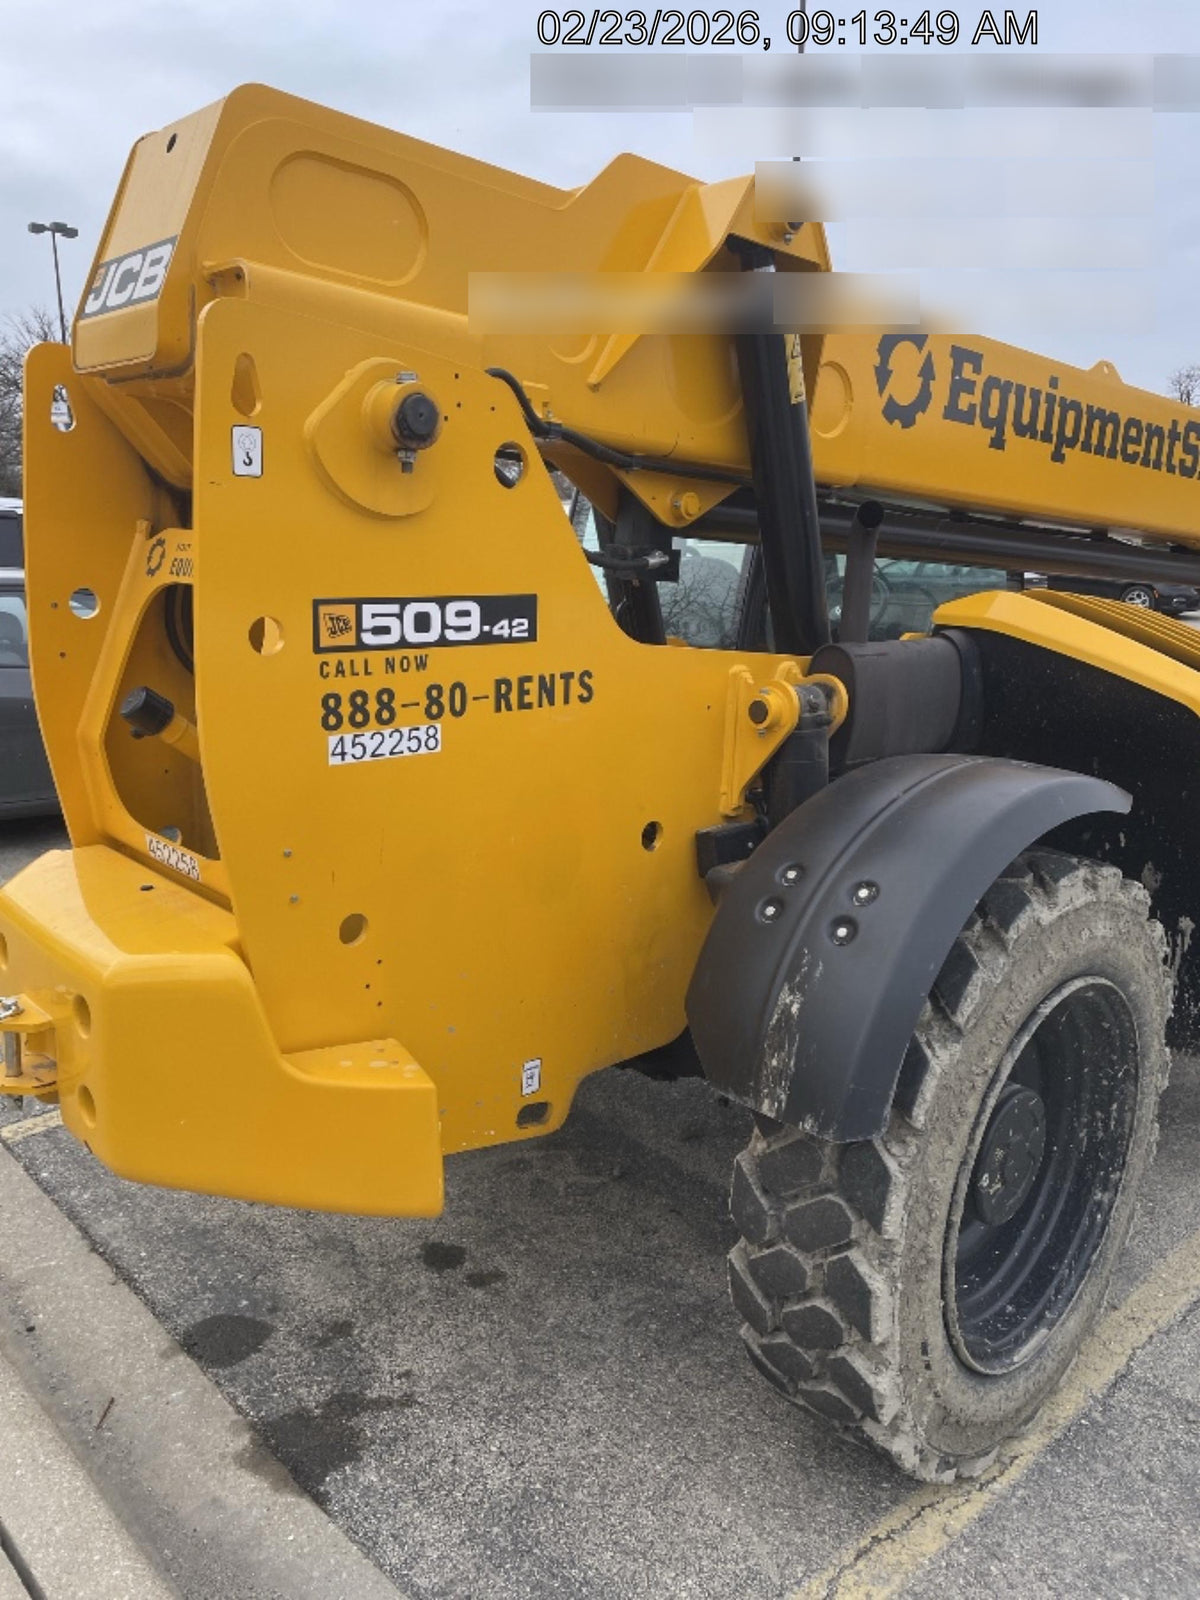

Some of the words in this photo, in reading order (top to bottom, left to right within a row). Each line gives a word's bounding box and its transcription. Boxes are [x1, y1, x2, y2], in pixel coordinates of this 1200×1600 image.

[84, 243, 173, 314] JCB
[943, 344, 1200, 481] EquipmentS
[319, 658, 373, 679] CALL
[385, 654, 429, 674] NOW
[321, 670, 594, 732] 888-80-RENTS
[330, 725, 440, 762] 452258
[148, 838, 200, 881] 452258
